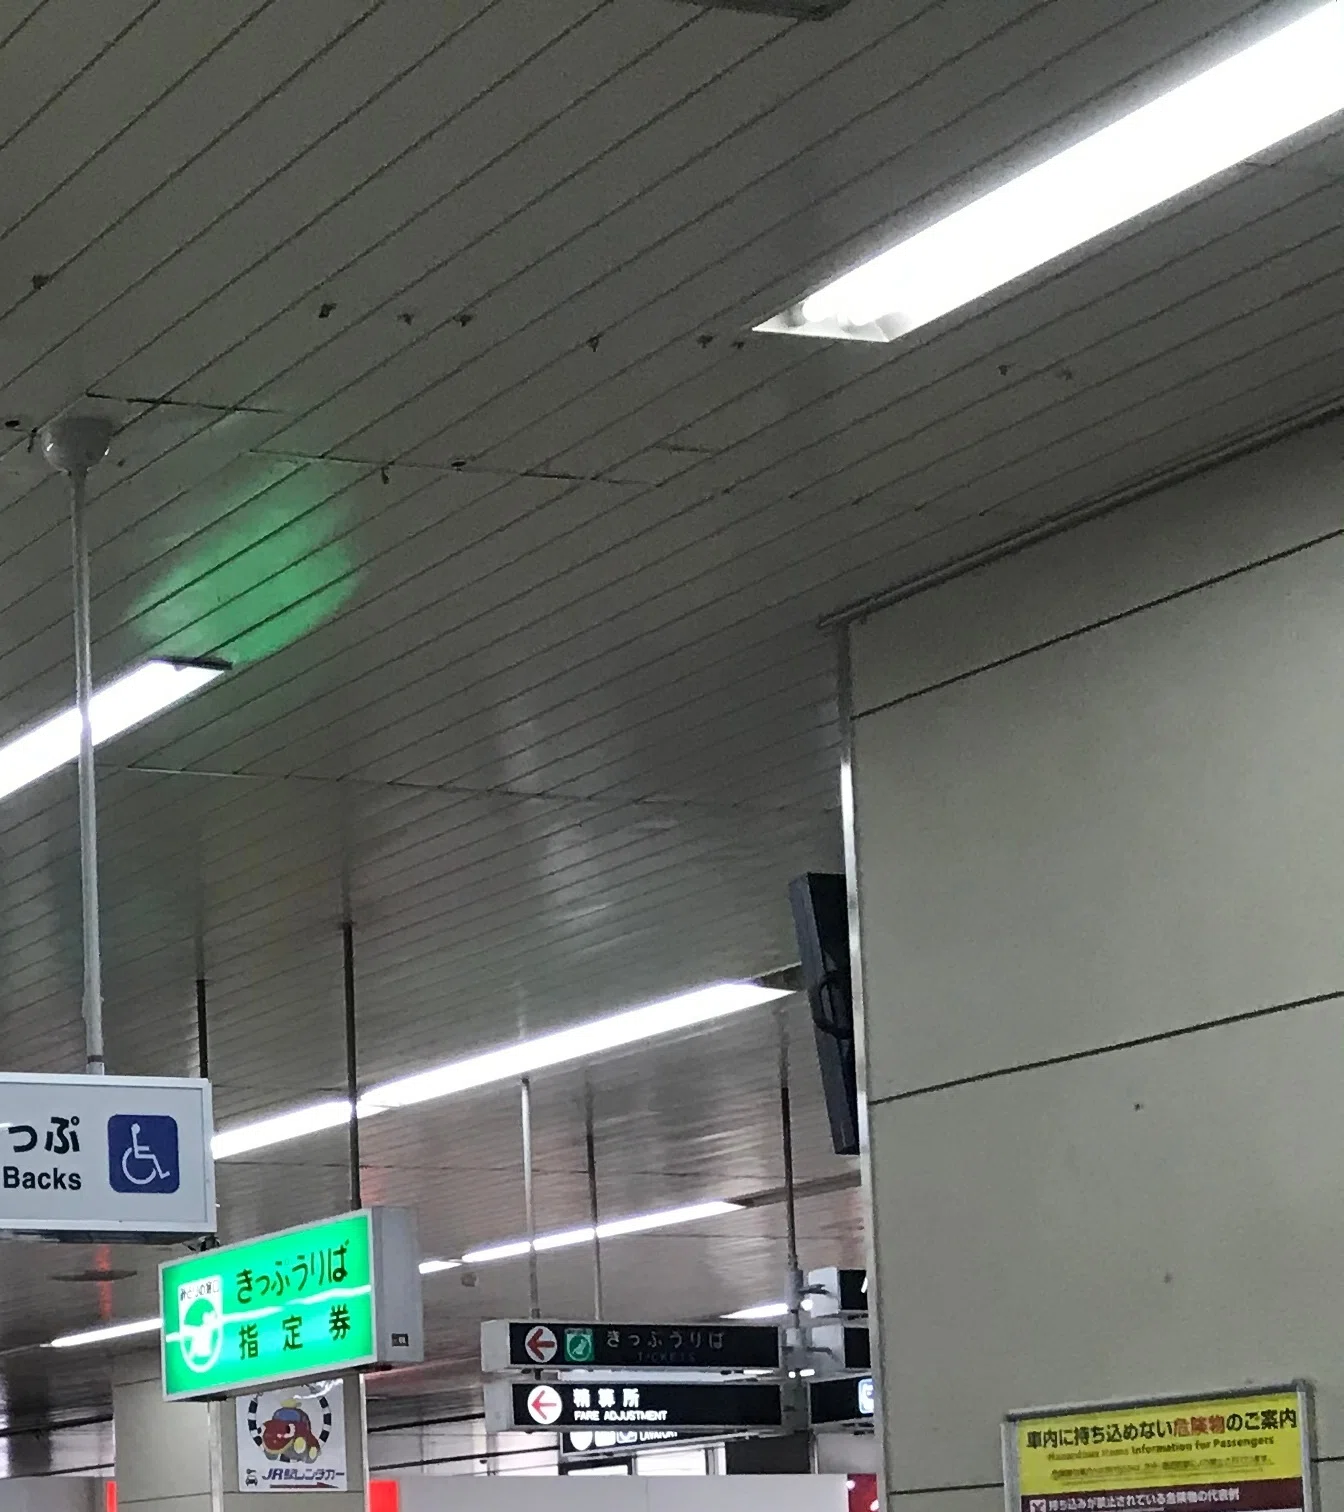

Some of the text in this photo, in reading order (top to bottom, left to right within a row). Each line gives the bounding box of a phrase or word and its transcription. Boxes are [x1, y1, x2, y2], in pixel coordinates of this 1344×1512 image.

[3, 1166, 82, 1191] Backs
[239, 1304, 351, 1360] 指定券
[574, 1410, 668, 1421] FARE ADJUSTMENT
[1214, 1436, 1274, 1449] Passengers
